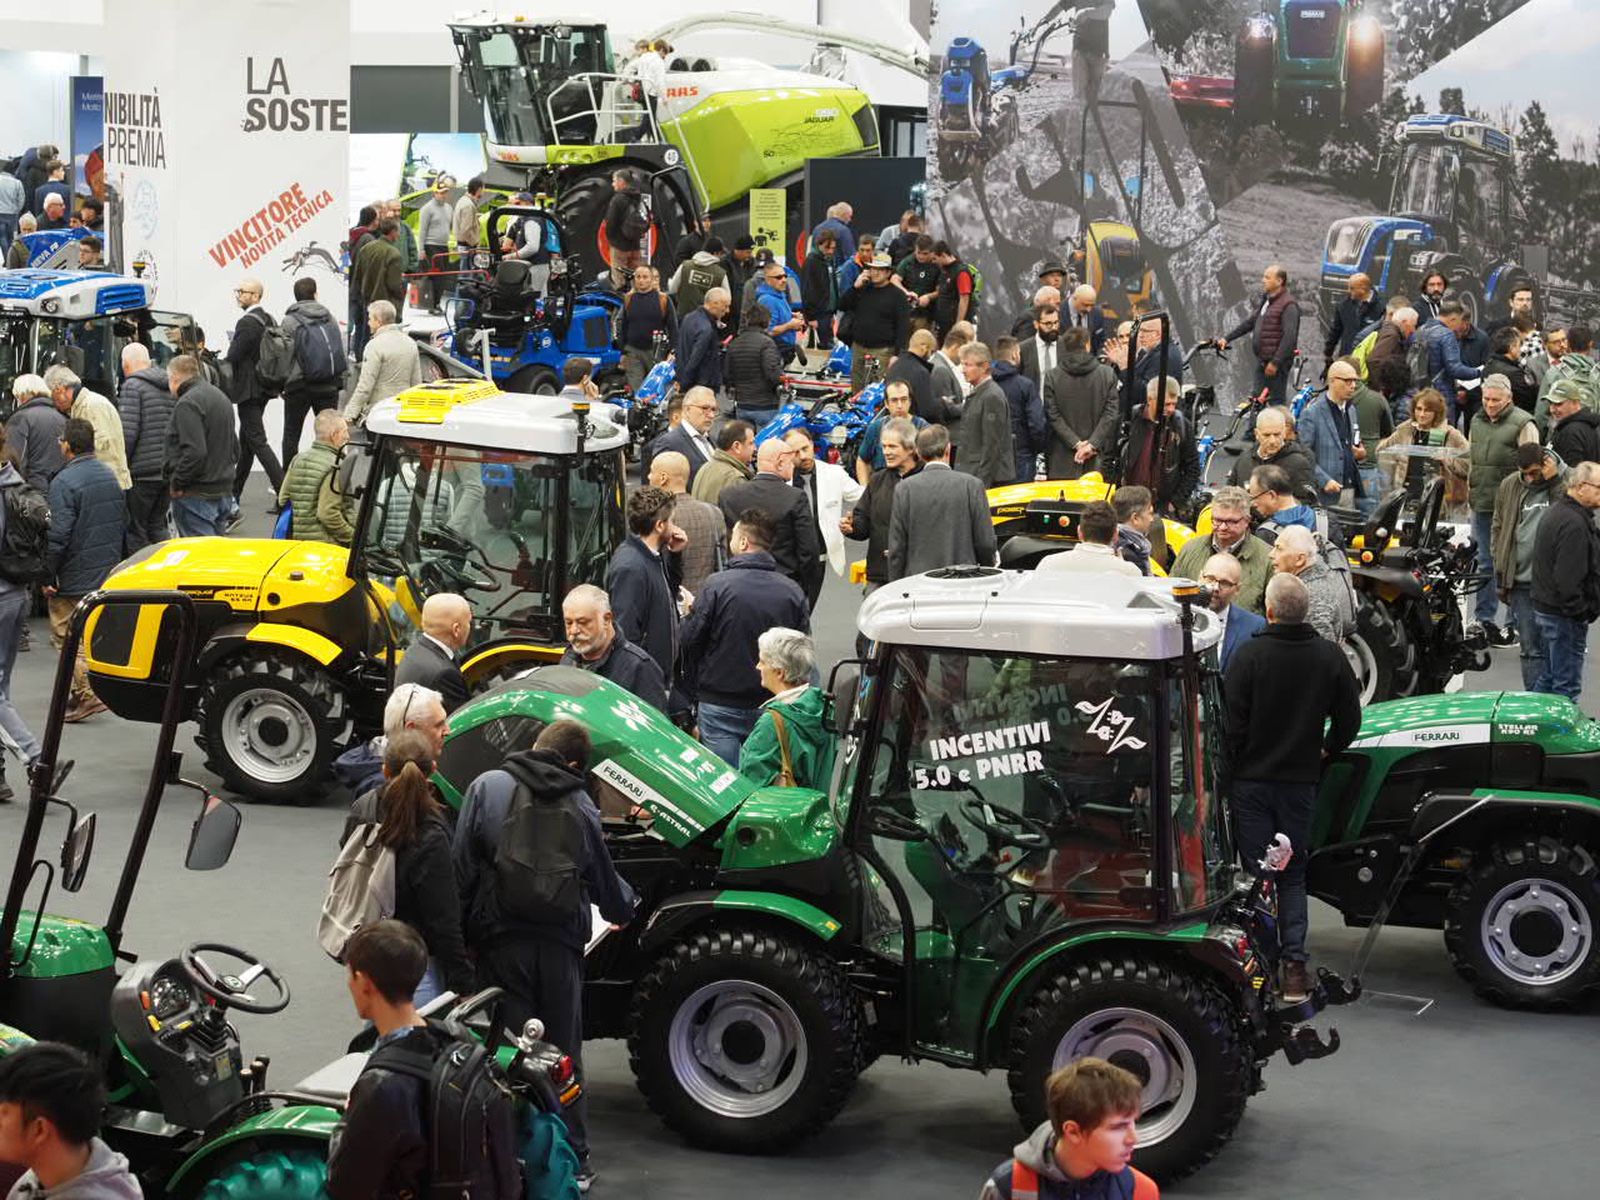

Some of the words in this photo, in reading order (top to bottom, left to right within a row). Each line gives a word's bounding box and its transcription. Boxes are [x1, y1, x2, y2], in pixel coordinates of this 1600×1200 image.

[247, 57, 290, 95] LA
[104, 86, 161, 129] NIBILITÀ
[246, 98, 348, 132] SOSTE
[108, 126, 166, 170] PREMIA
[209, 182, 307, 268] VINCITORE
[284, 190, 334, 233] TECNICA
[929, 721, 1051, 760] INCENTIVI
[1414, 732, 1460, 741] FERRARI
[602, 765, 644, 798] FERRARI
[915, 764, 951, 790] 5.0
[958, 767, 971, 783] e
[976, 750, 1045, 781] PNRR
